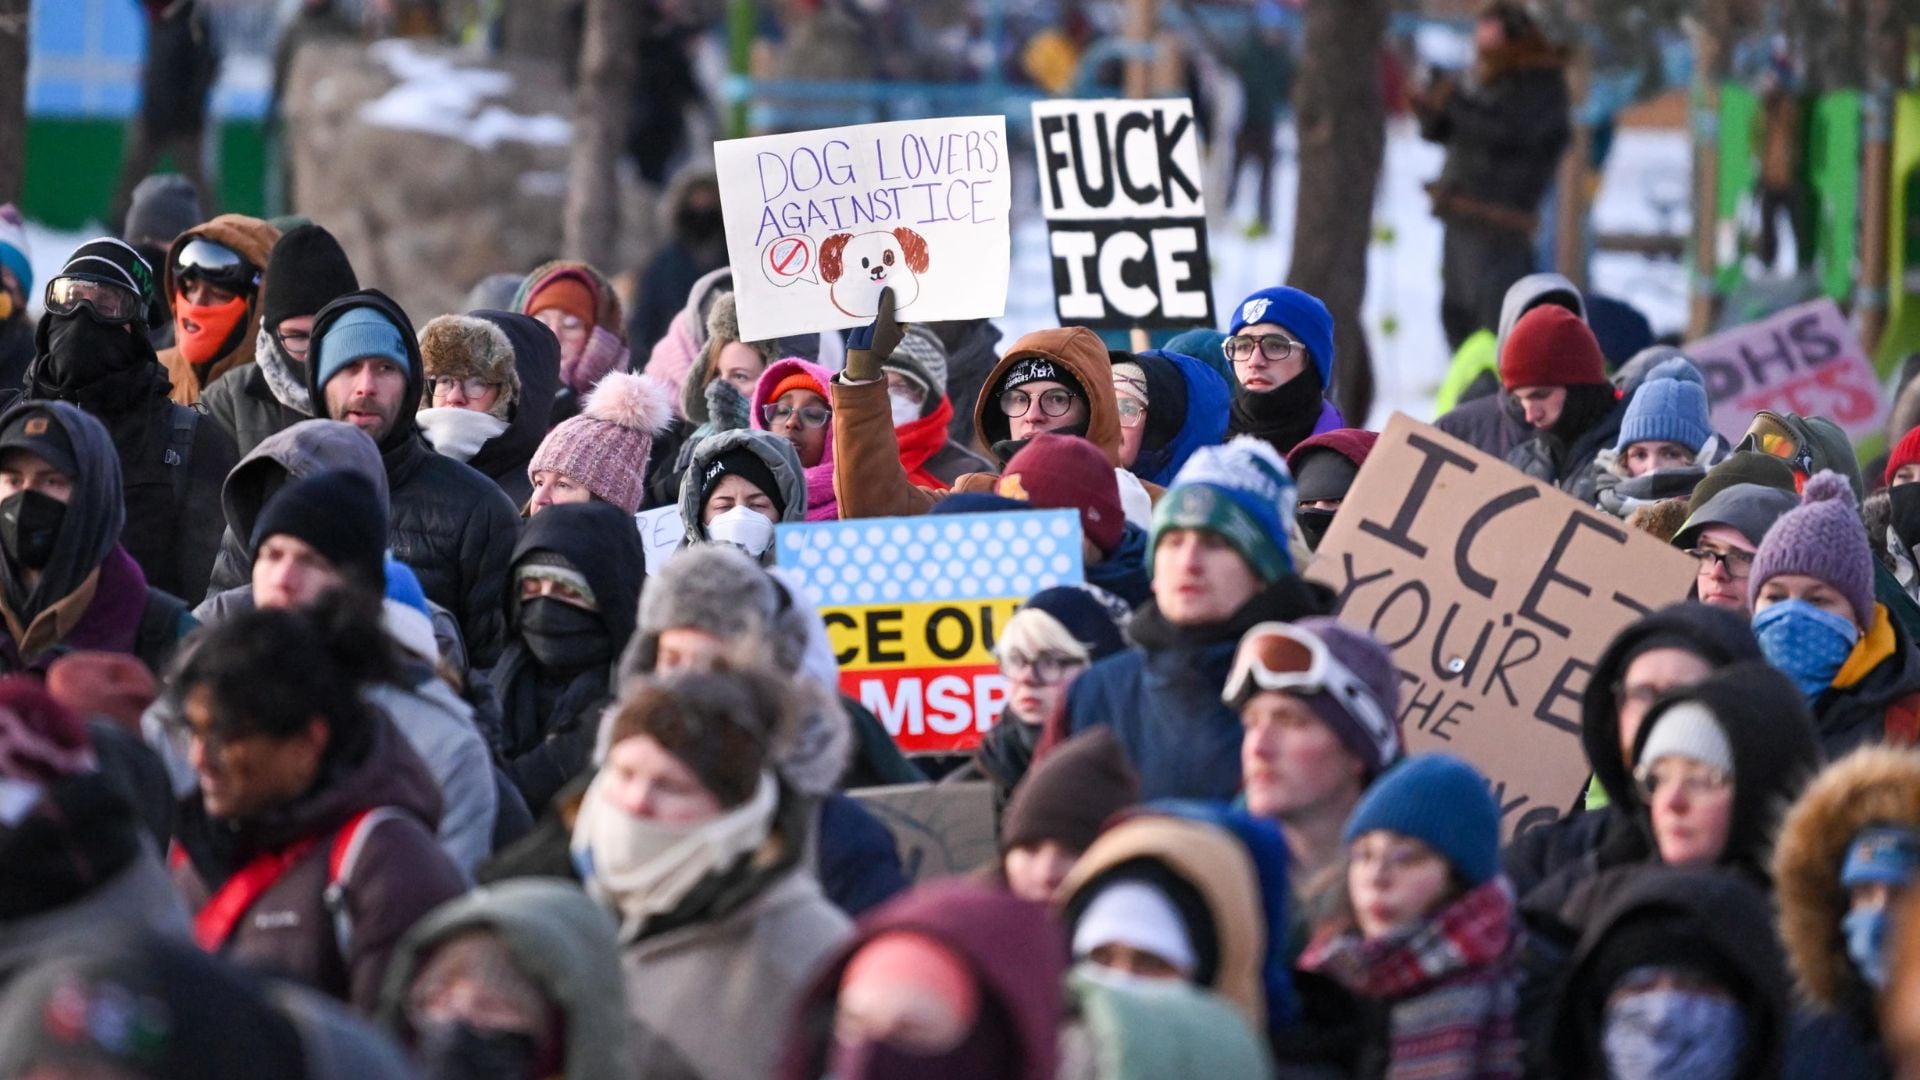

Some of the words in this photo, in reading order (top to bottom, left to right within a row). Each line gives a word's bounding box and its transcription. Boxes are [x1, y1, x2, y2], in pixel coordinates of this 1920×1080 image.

[757, 140, 856, 203] DOG
[877, 130, 999, 181] LOVERS
[1040, 109, 1200, 209] FUCK
[755, 186, 908, 246] AGAINST
[912, 179, 996, 224] ICE
[1051, 227, 1208, 318] ICE
[1702, 312, 1842, 403] DHS
[821, 609, 906, 666] CE
[925, 604, 1018, 661] OU
